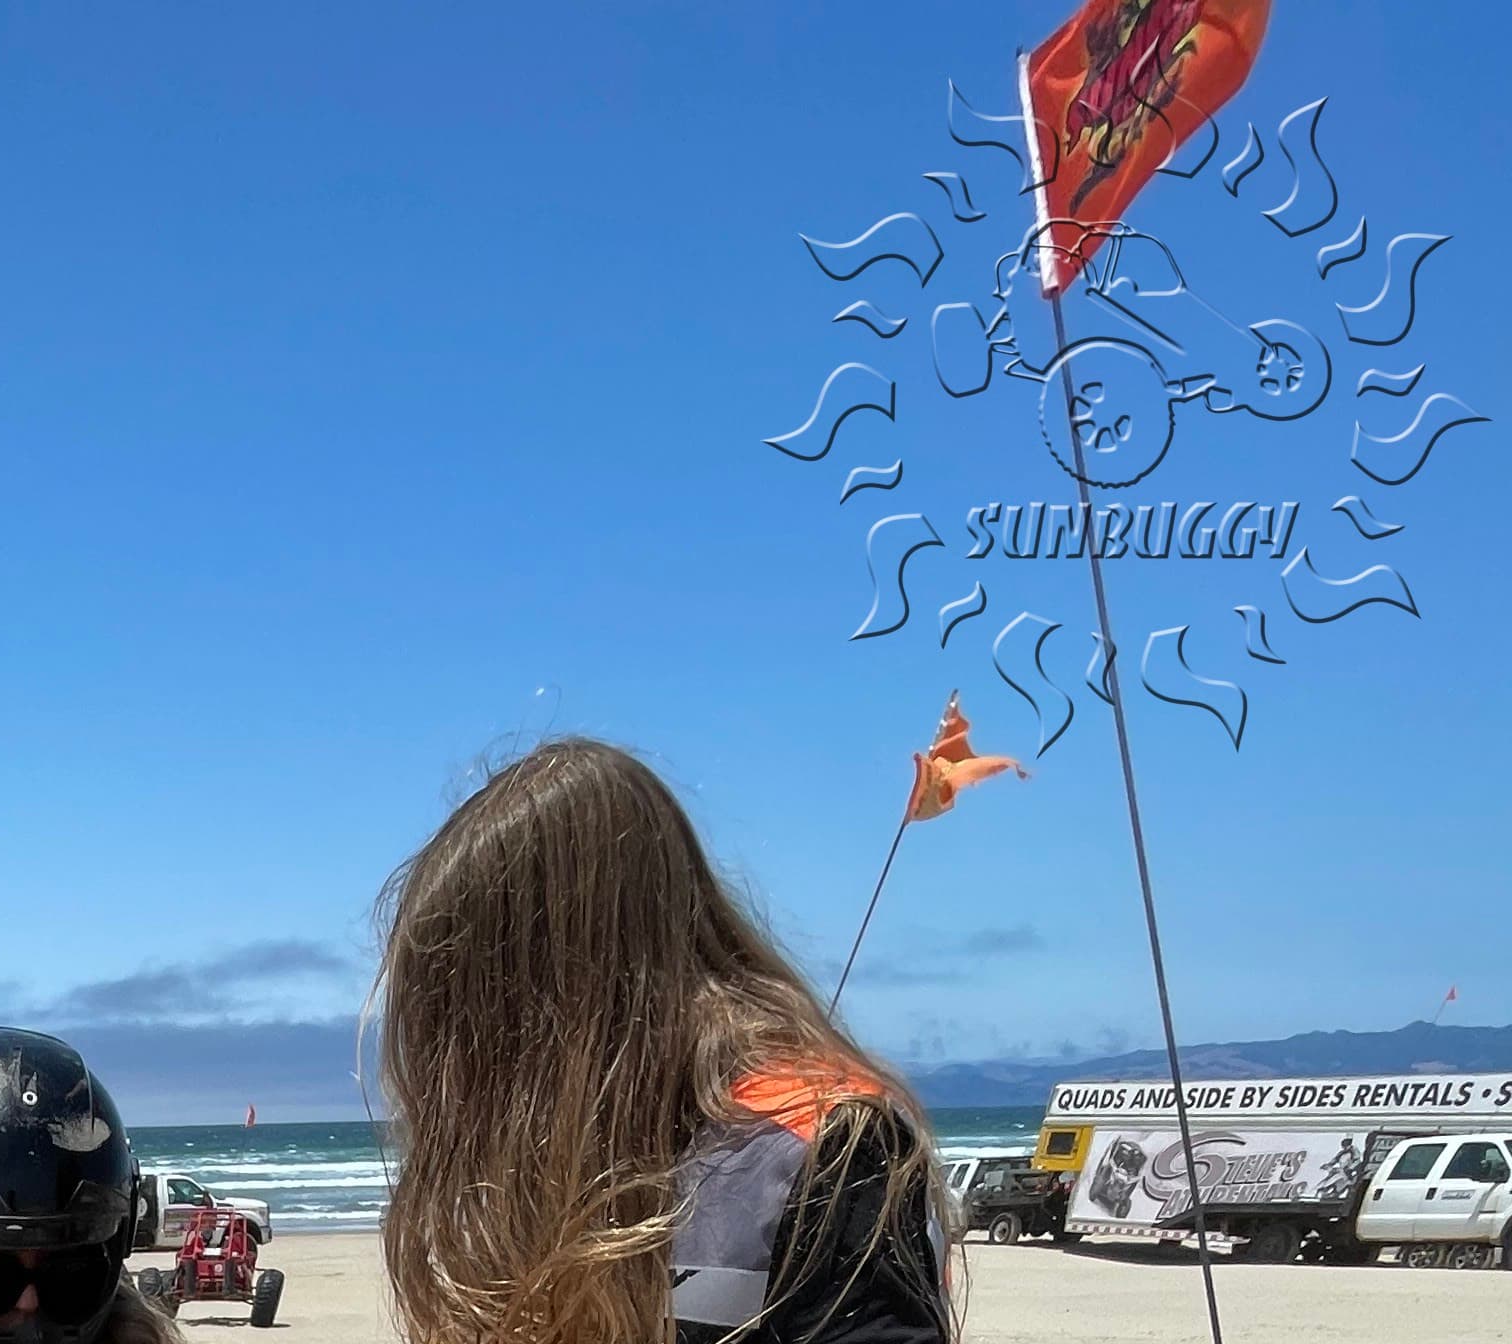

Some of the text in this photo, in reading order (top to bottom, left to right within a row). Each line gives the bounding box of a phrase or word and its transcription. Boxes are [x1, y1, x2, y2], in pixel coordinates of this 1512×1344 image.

[1057, 1088, 1128, 1111] QUADS
[1129, 1087, 1177, 1110] AND
[1184, 1086, 1236, 1110] SIDE
[1239, 1086, 1274, 1109] BY
[1275, 1084, 1348, 1109] SIDES
[1351, 1081, 1475, 1108] RENTALS
